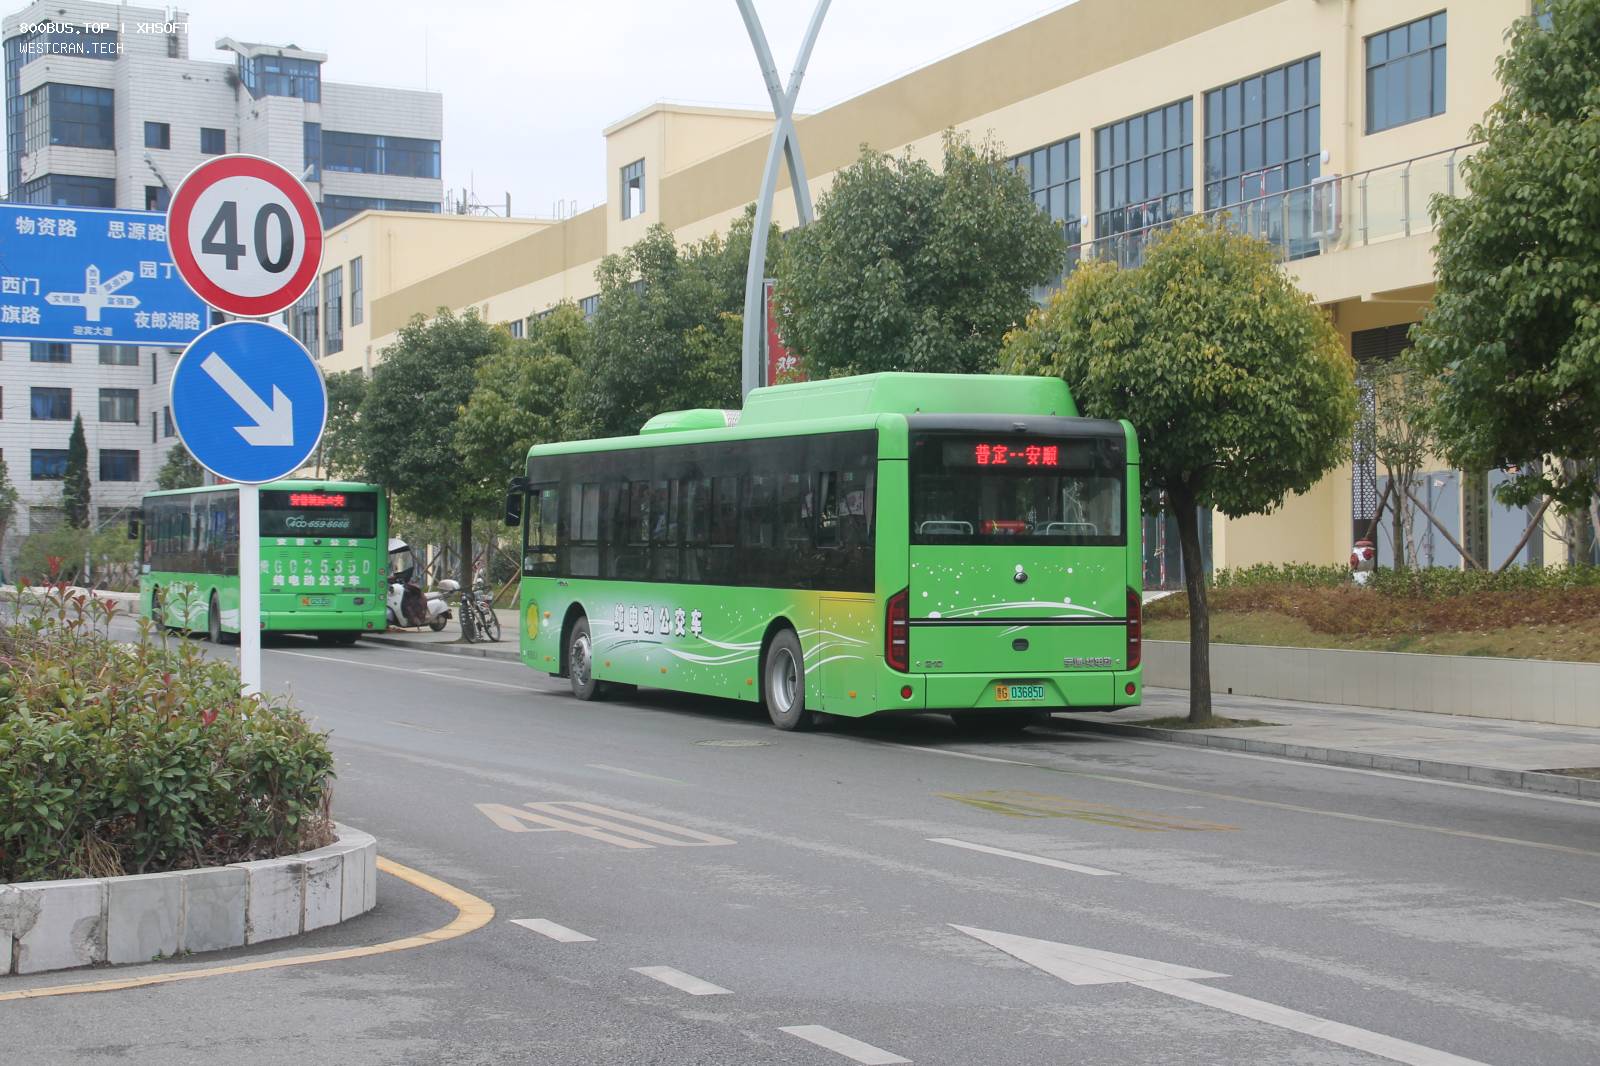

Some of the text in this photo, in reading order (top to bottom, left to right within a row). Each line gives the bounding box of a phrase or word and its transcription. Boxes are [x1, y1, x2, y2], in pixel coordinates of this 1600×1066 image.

[15, 215, 78, 238] 物资路
[107, 220, 167, 242] 思源路
[200, 200, 294, 274] 40
[139, 260, 175, 280] 园丁
[1, 276, 40, 296] 西门
[133, 310, 201, 331] 夜郎湖路
[473, 801, 738, 849] 40
